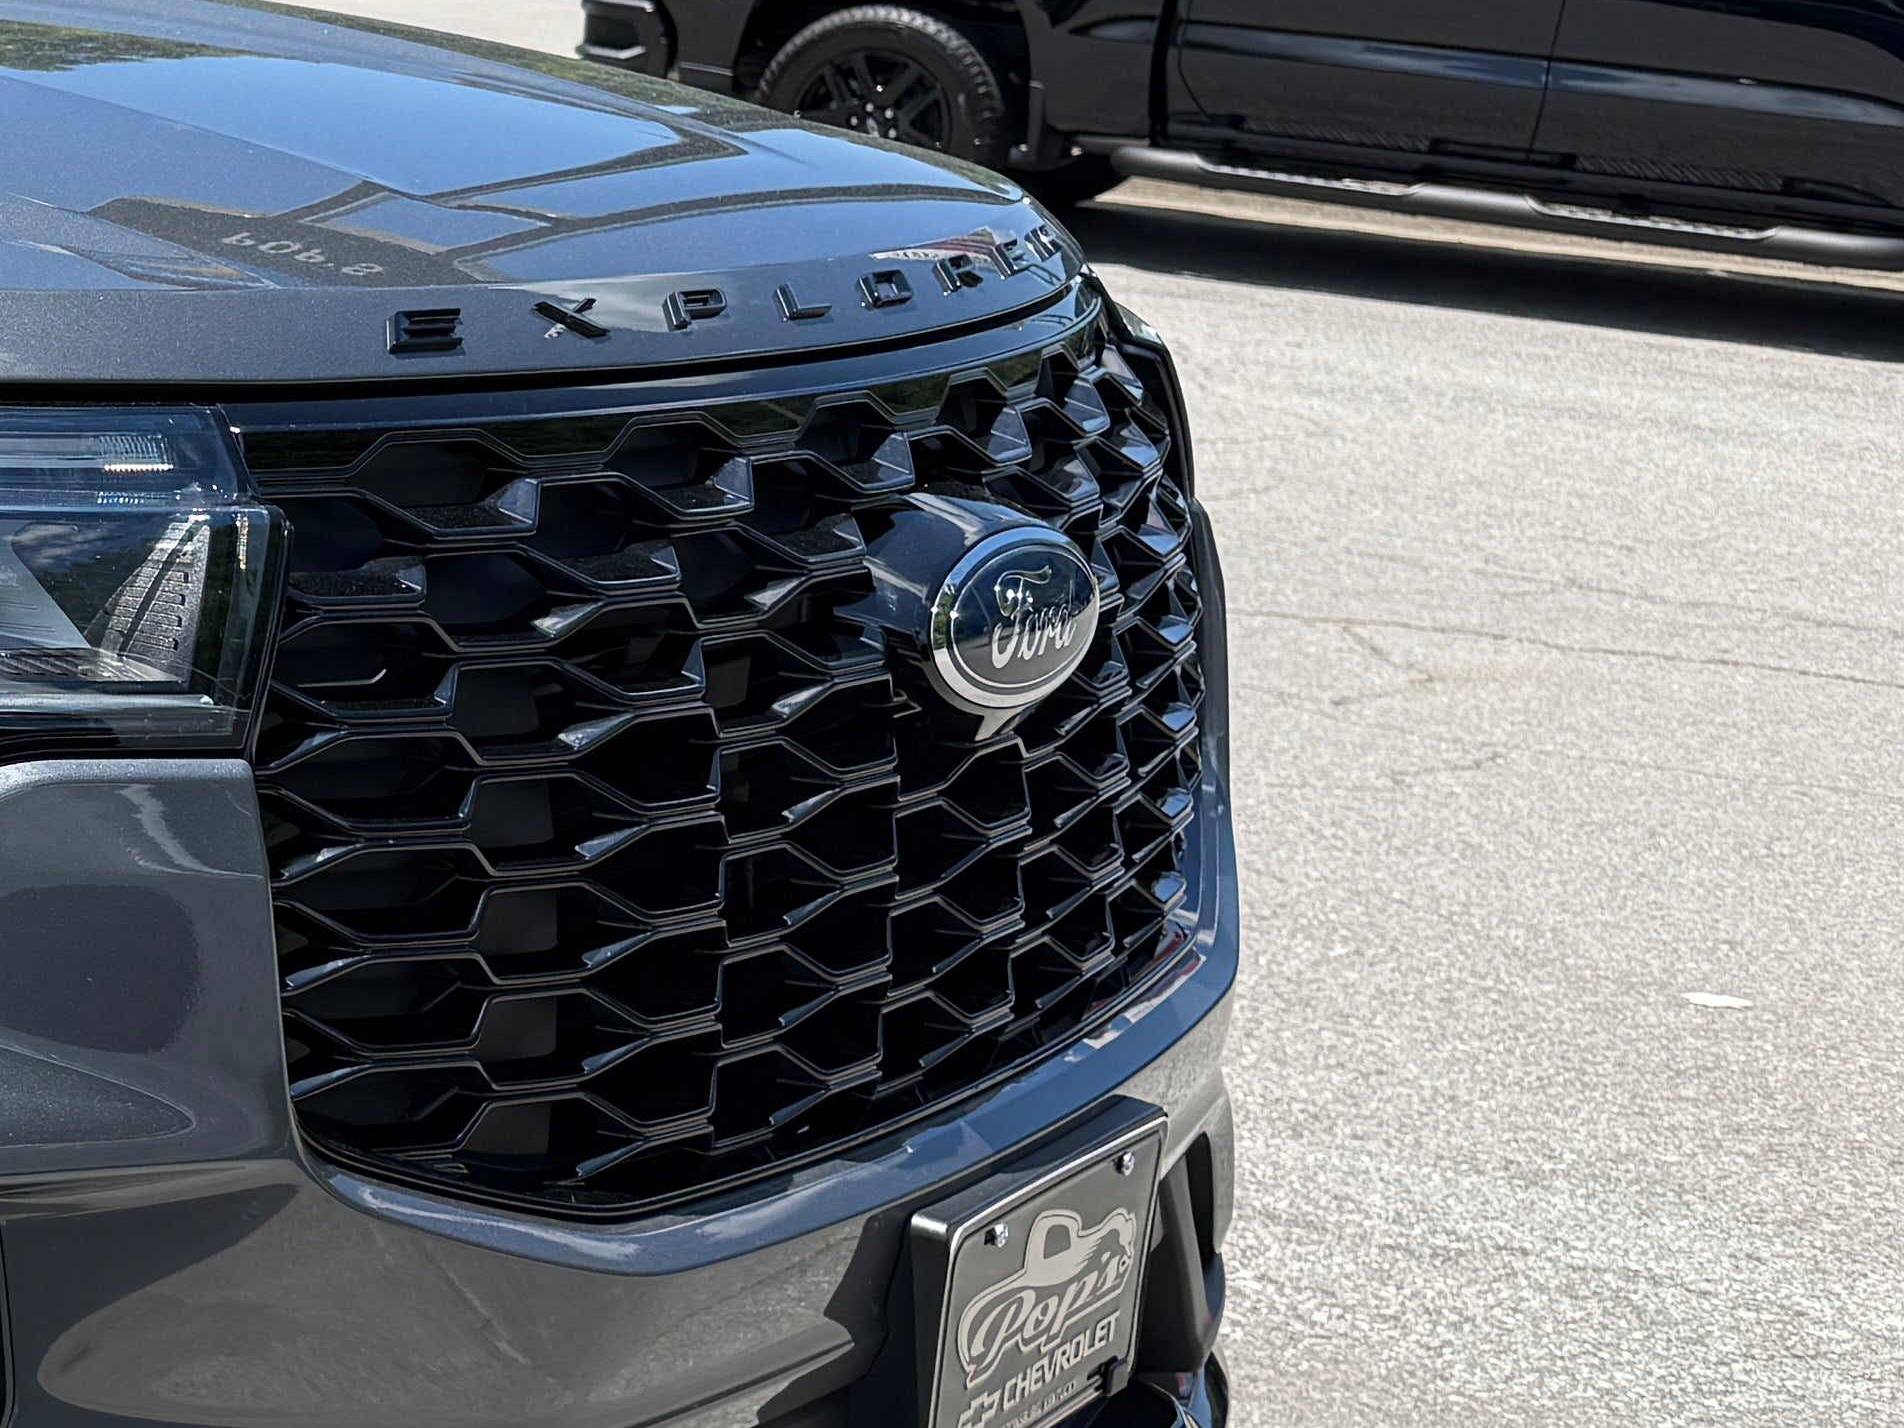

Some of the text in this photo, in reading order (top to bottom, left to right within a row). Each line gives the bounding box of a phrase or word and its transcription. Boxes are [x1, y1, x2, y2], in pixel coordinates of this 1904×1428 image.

[386, 223, 1064, 356] EXPLORER
[991, 564, 1079, 670] Ford
[970, 1252, 1124, 1369] Pop's
[1002, 1310, 1120, 1412] CHEVROLET
